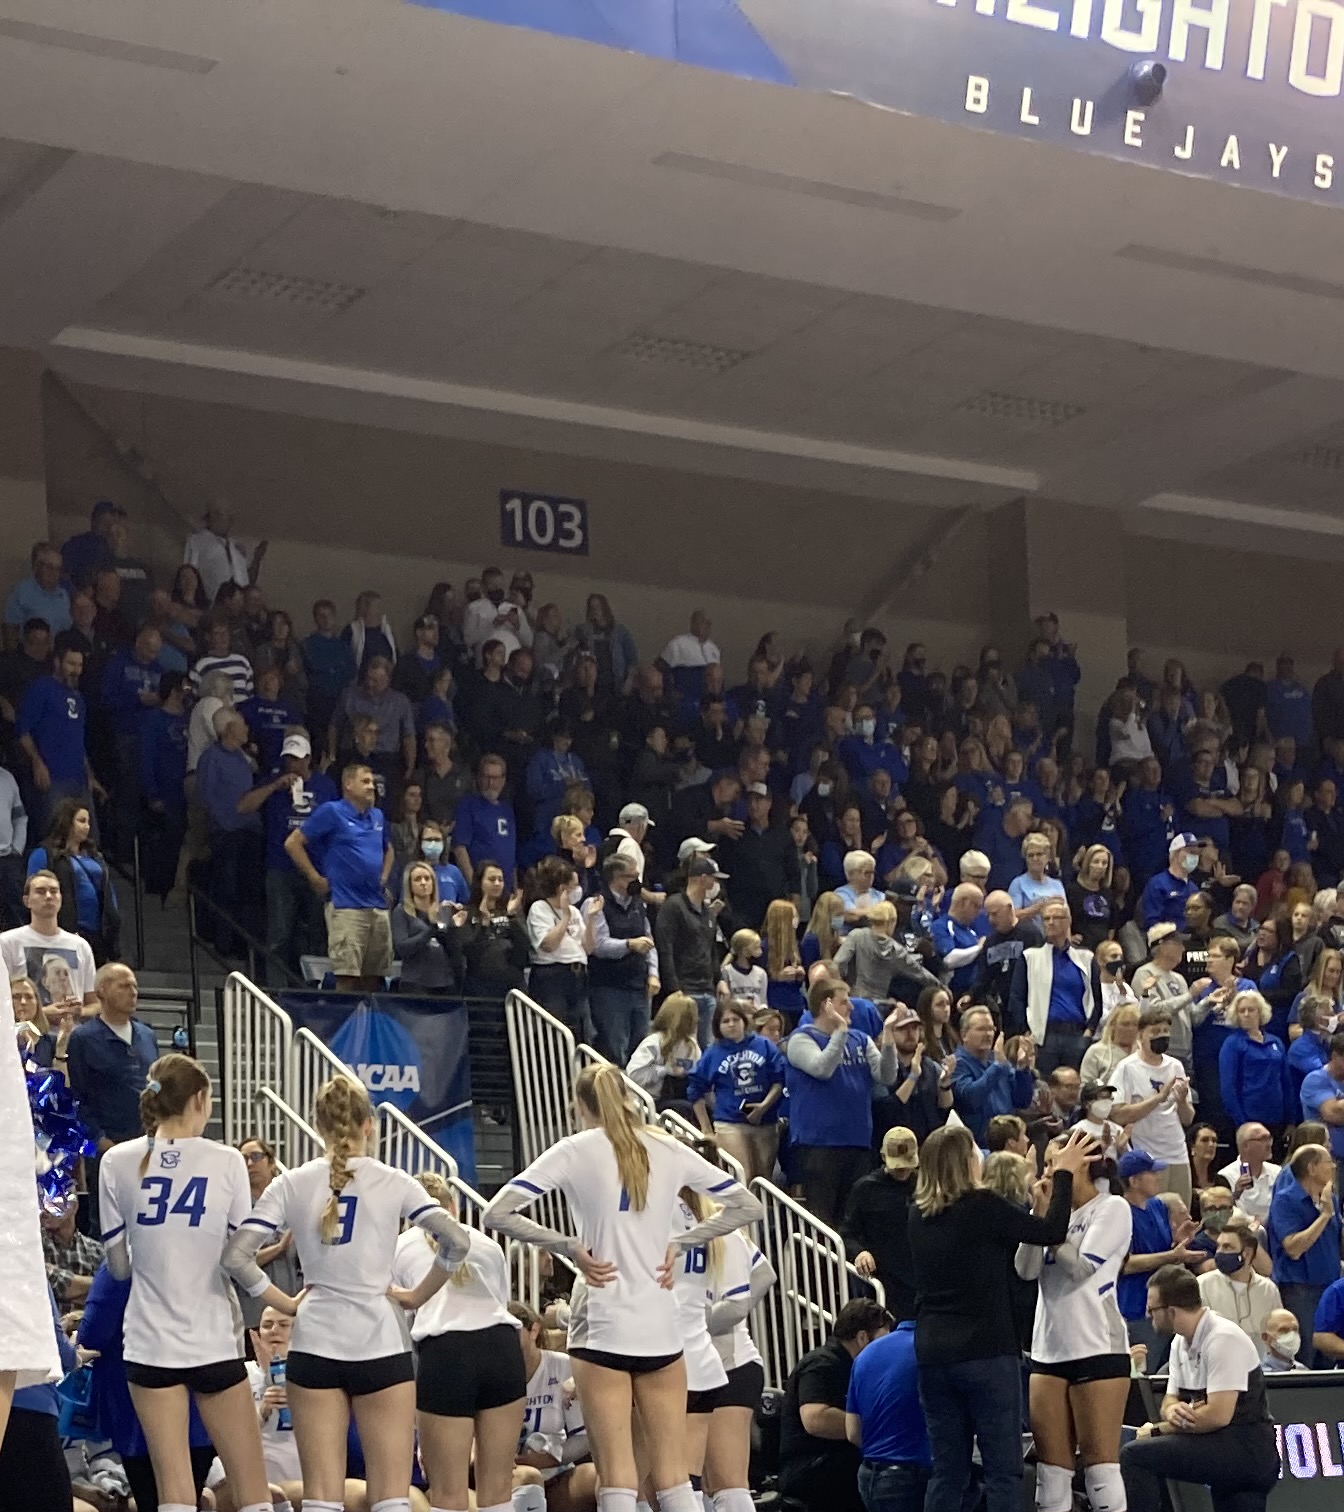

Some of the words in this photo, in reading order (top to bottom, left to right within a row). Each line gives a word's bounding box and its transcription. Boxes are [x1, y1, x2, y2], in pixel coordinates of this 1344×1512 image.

[964, 75, 1336, 190] BLUEJAYS
[505, 497, 584, 549] 103
[136, 1182, 209, 1228] 34
